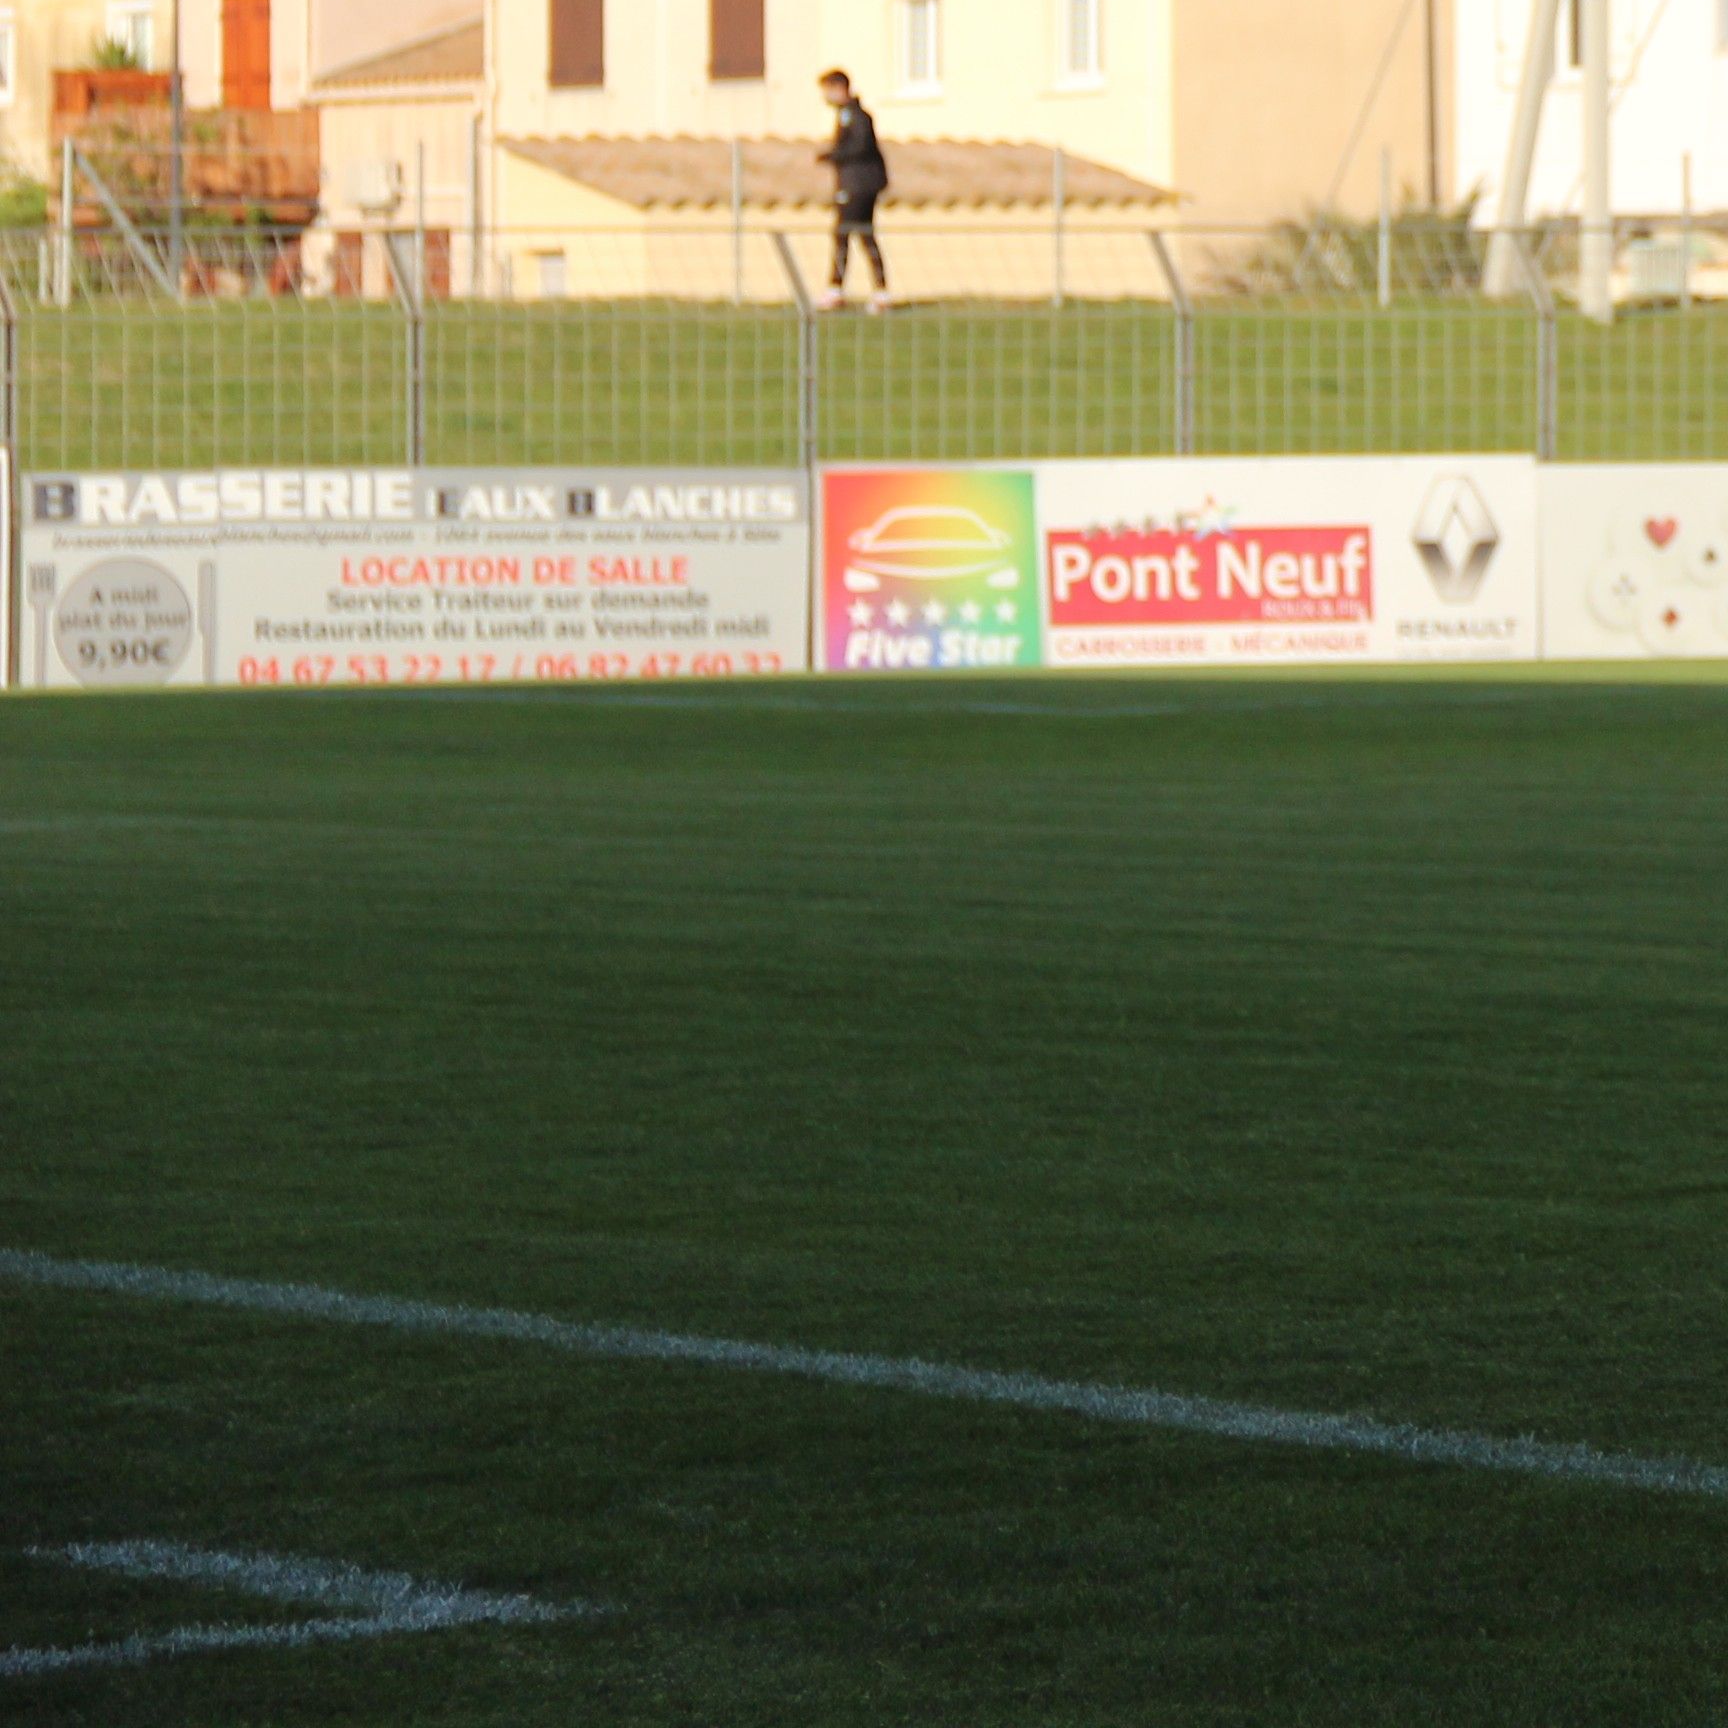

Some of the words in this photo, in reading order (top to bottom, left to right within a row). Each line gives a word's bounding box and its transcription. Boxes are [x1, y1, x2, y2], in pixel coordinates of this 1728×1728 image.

[33, 474, 413, 524] BRASSERIE
[424, 485, 554, 520] EAUX
[566, 485, 796, 520] BLANCHES
[341, 555, 520, 587] LOCATION
[533, 555, 576, 586] DE
[587, 555, 689, 586] SALLE
[1051, 542, 1200, 604] Pont
[1215, 533, 1369, 601] Neuf
[327, 589, 422, 612] Service
[433, 588, 533, 611] Traiteur
[544, 593, 582, 610] sur
[591, 588, 710, 610] demande
[253, 618, 425, 642] Restauration
[433, 617, 467, 640] du
[476, 616, 546, 640] Lundi
[554, 622, 586, 639] au
[594, 616, 708, 640] Vendredi
[715, 615, 771, 637] midi
[1395, 617, 1518, 640] RENAULT
[843, 629, 933, 668] Five
[938, 628, 1022, 667] Star
